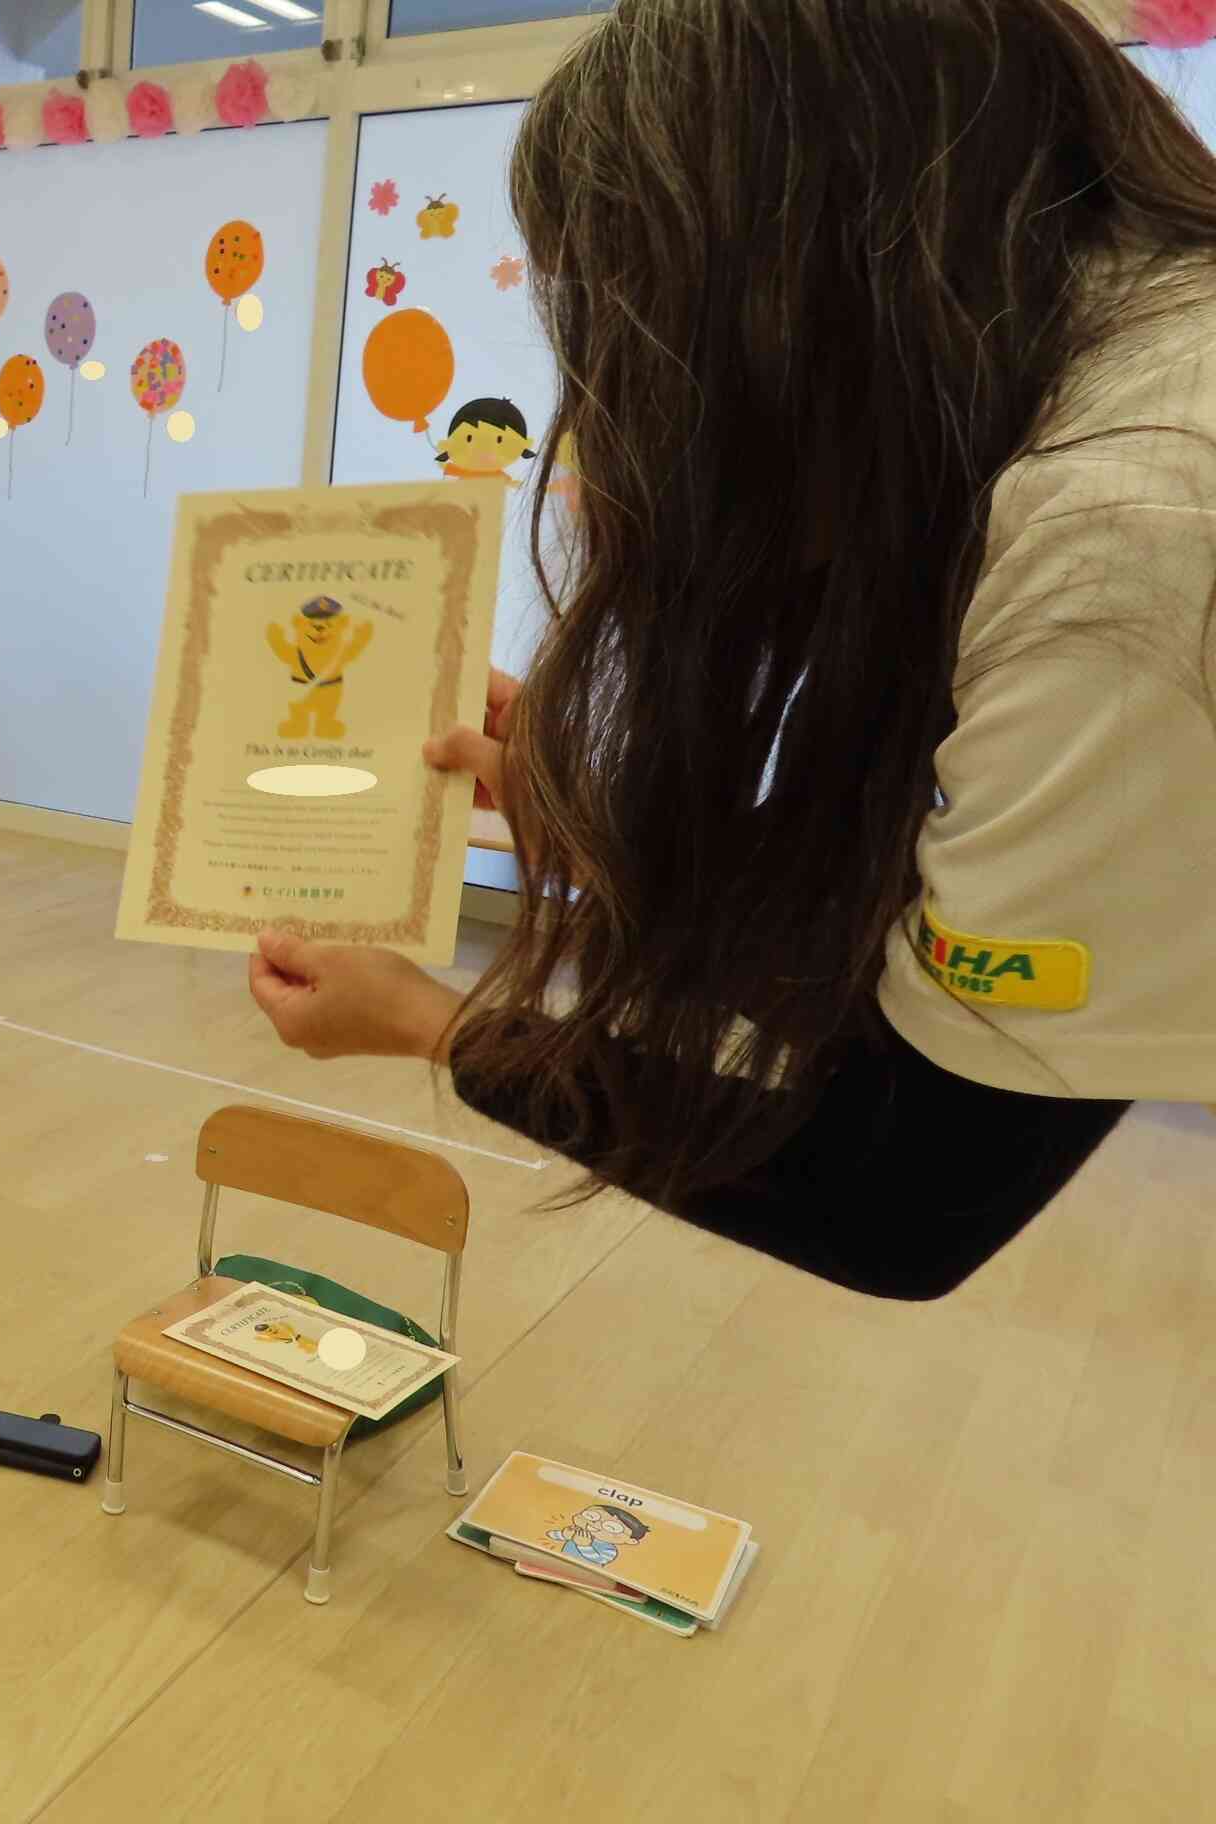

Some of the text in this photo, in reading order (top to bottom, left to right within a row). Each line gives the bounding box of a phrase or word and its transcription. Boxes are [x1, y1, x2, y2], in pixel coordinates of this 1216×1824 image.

[245, 560, 415, 584] CERTIFICATE
[948, 971, 993, 993] 1985
[597, 1485, 644, 1508] clap
